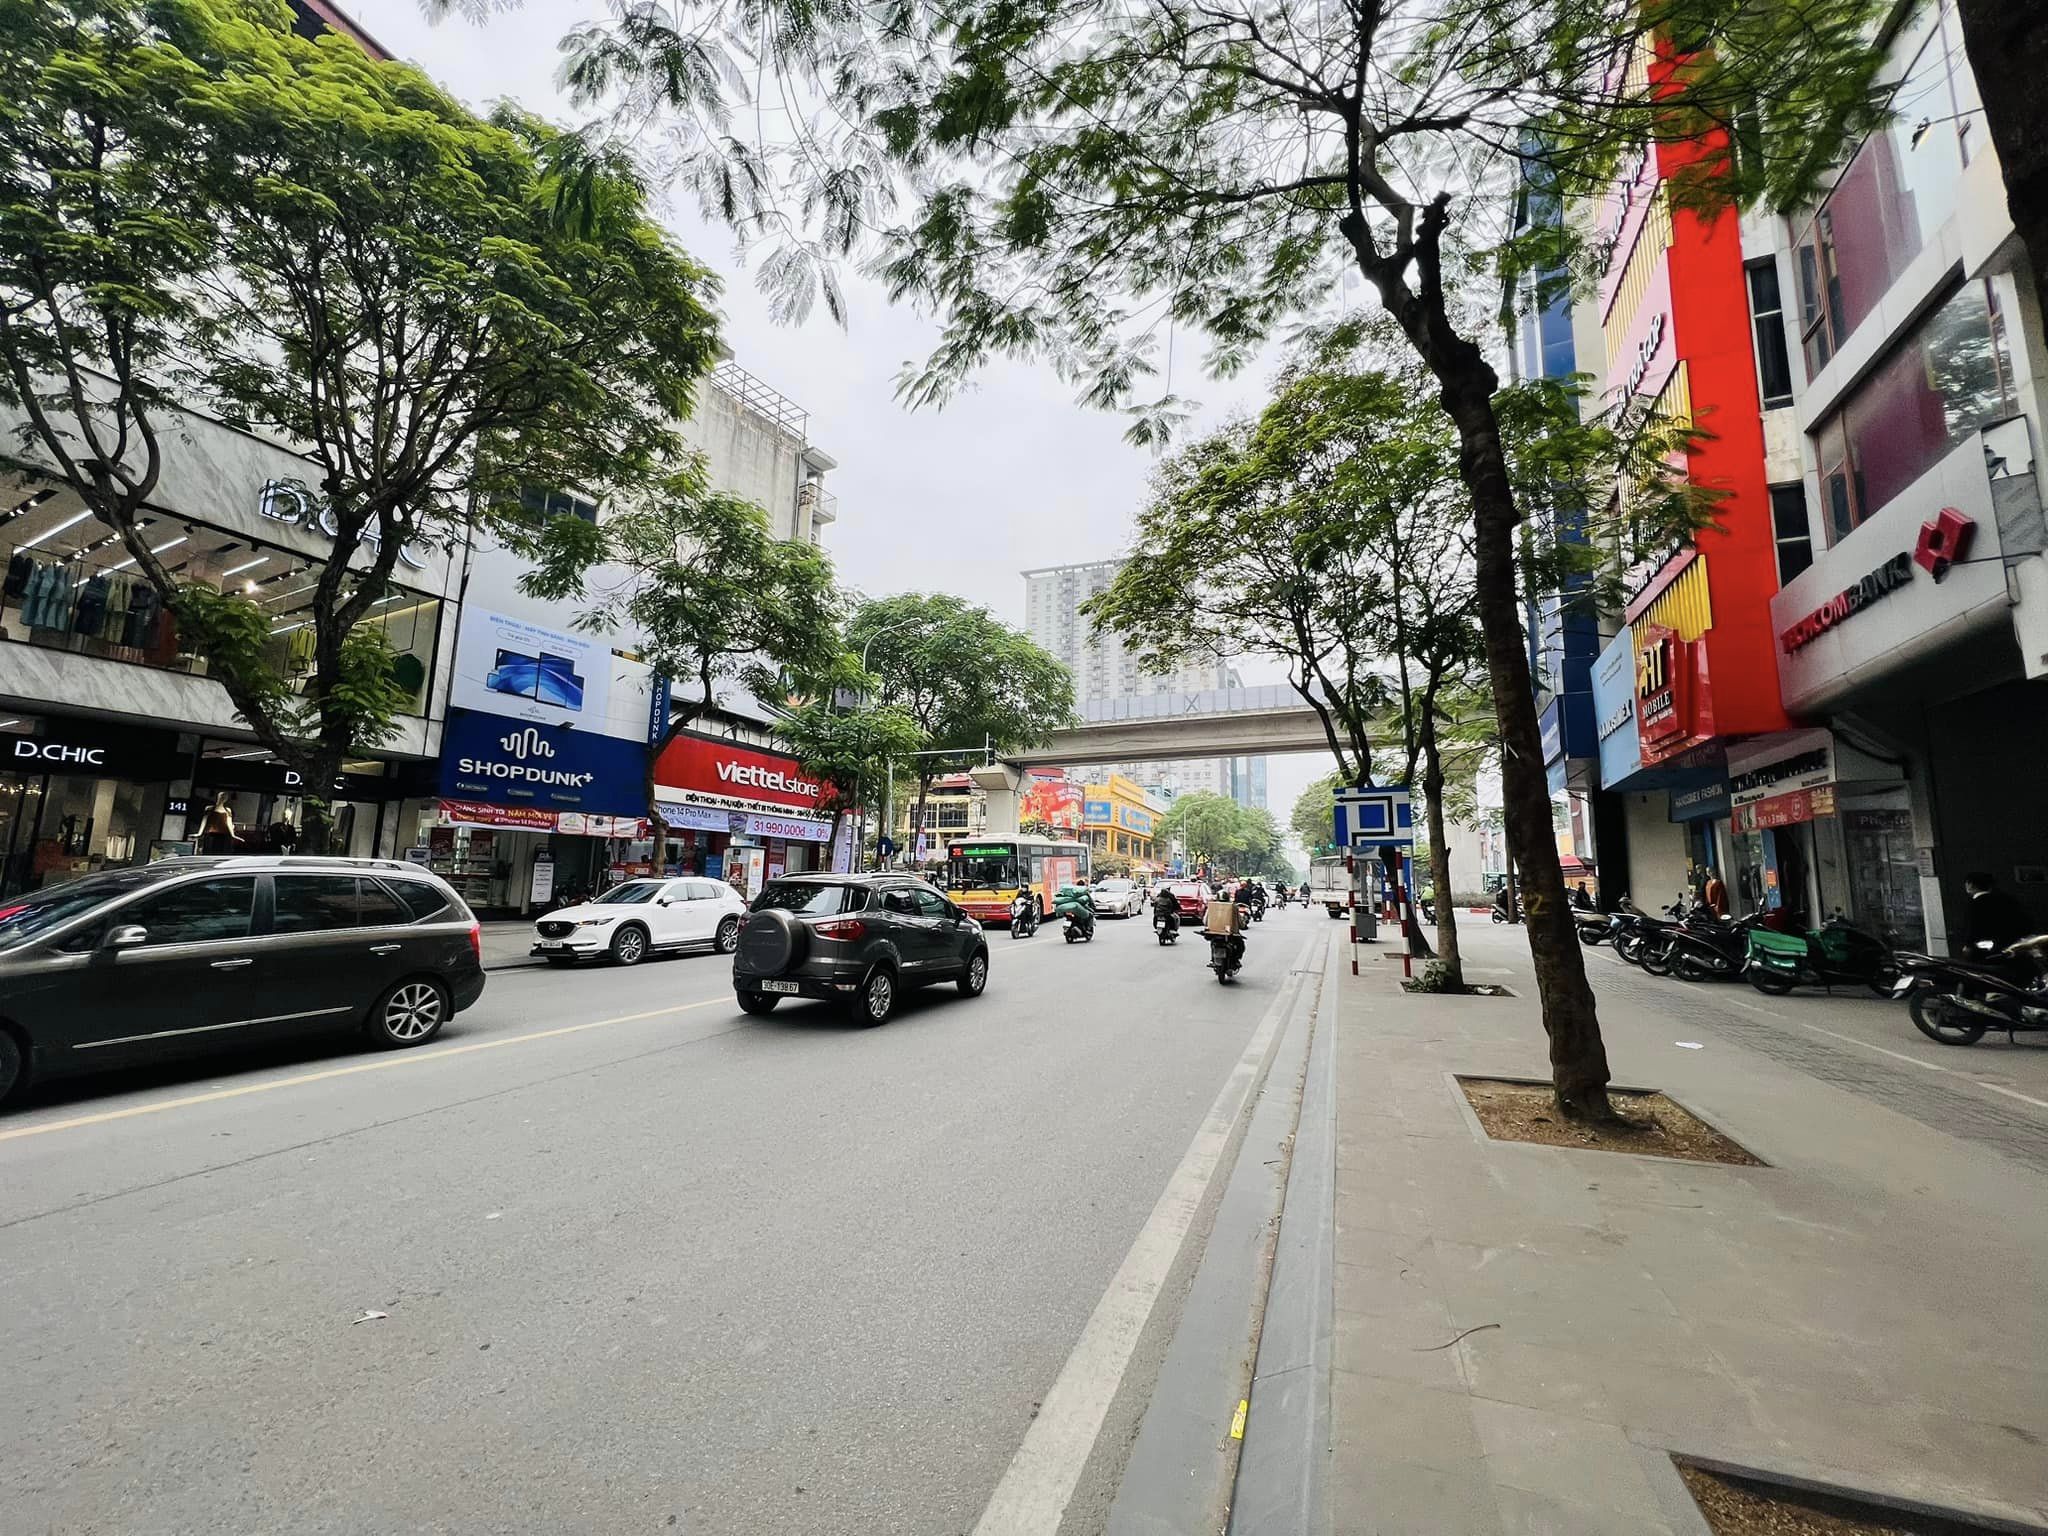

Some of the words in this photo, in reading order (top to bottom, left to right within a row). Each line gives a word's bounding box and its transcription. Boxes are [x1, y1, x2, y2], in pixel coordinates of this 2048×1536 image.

[1780, 552, 1914, 655] TECHCOMBANK
[1641, 690, 1671, 719] MOBILE
[14, 740, 105, 765] D.CHIC
[169, 801, 187, 811] 141
[676, 807, 685, 816] 14
[685, 808, 698, 818] Pro
[697, 809, 712, 819] Max
